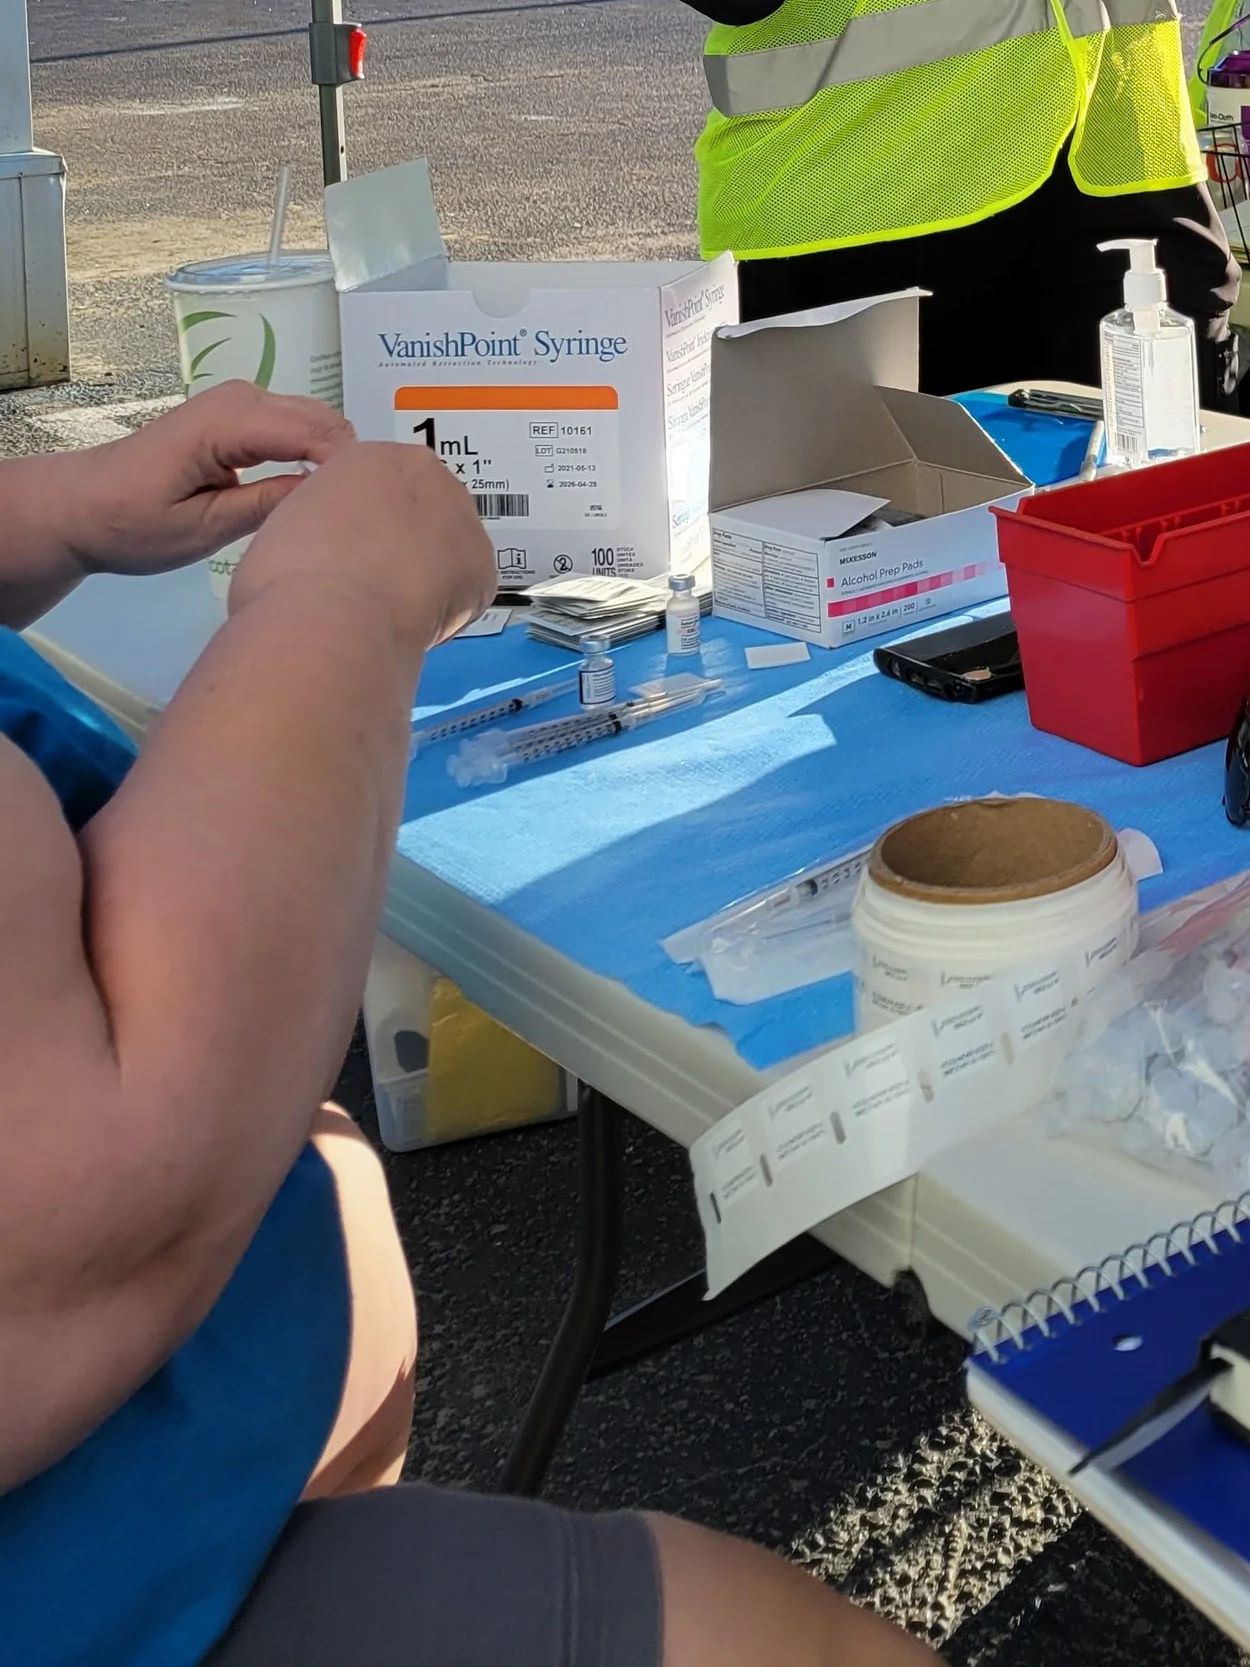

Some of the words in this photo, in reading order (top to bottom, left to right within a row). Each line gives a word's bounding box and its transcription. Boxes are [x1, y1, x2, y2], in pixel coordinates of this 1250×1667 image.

[534, 329, 628, 363] Syringe
[413, 417, 436, 454] 1
[440, 435, 479, 455] mL
[532, 425, 556, 435] REF
[561, 426, 592, 435] 10161
[455, 462, 466, 474] x
[471, 479, 510, 492] 25mm)
[591, 548, 614, 566] 100
[592, 567, 617, 577] UNITS
[840, 570, 878, 588] Alcohol
[880, 565, 900, 580] Prep
[902, 558, 924, 573] Pads
[903, 602, 916, 612] 200
